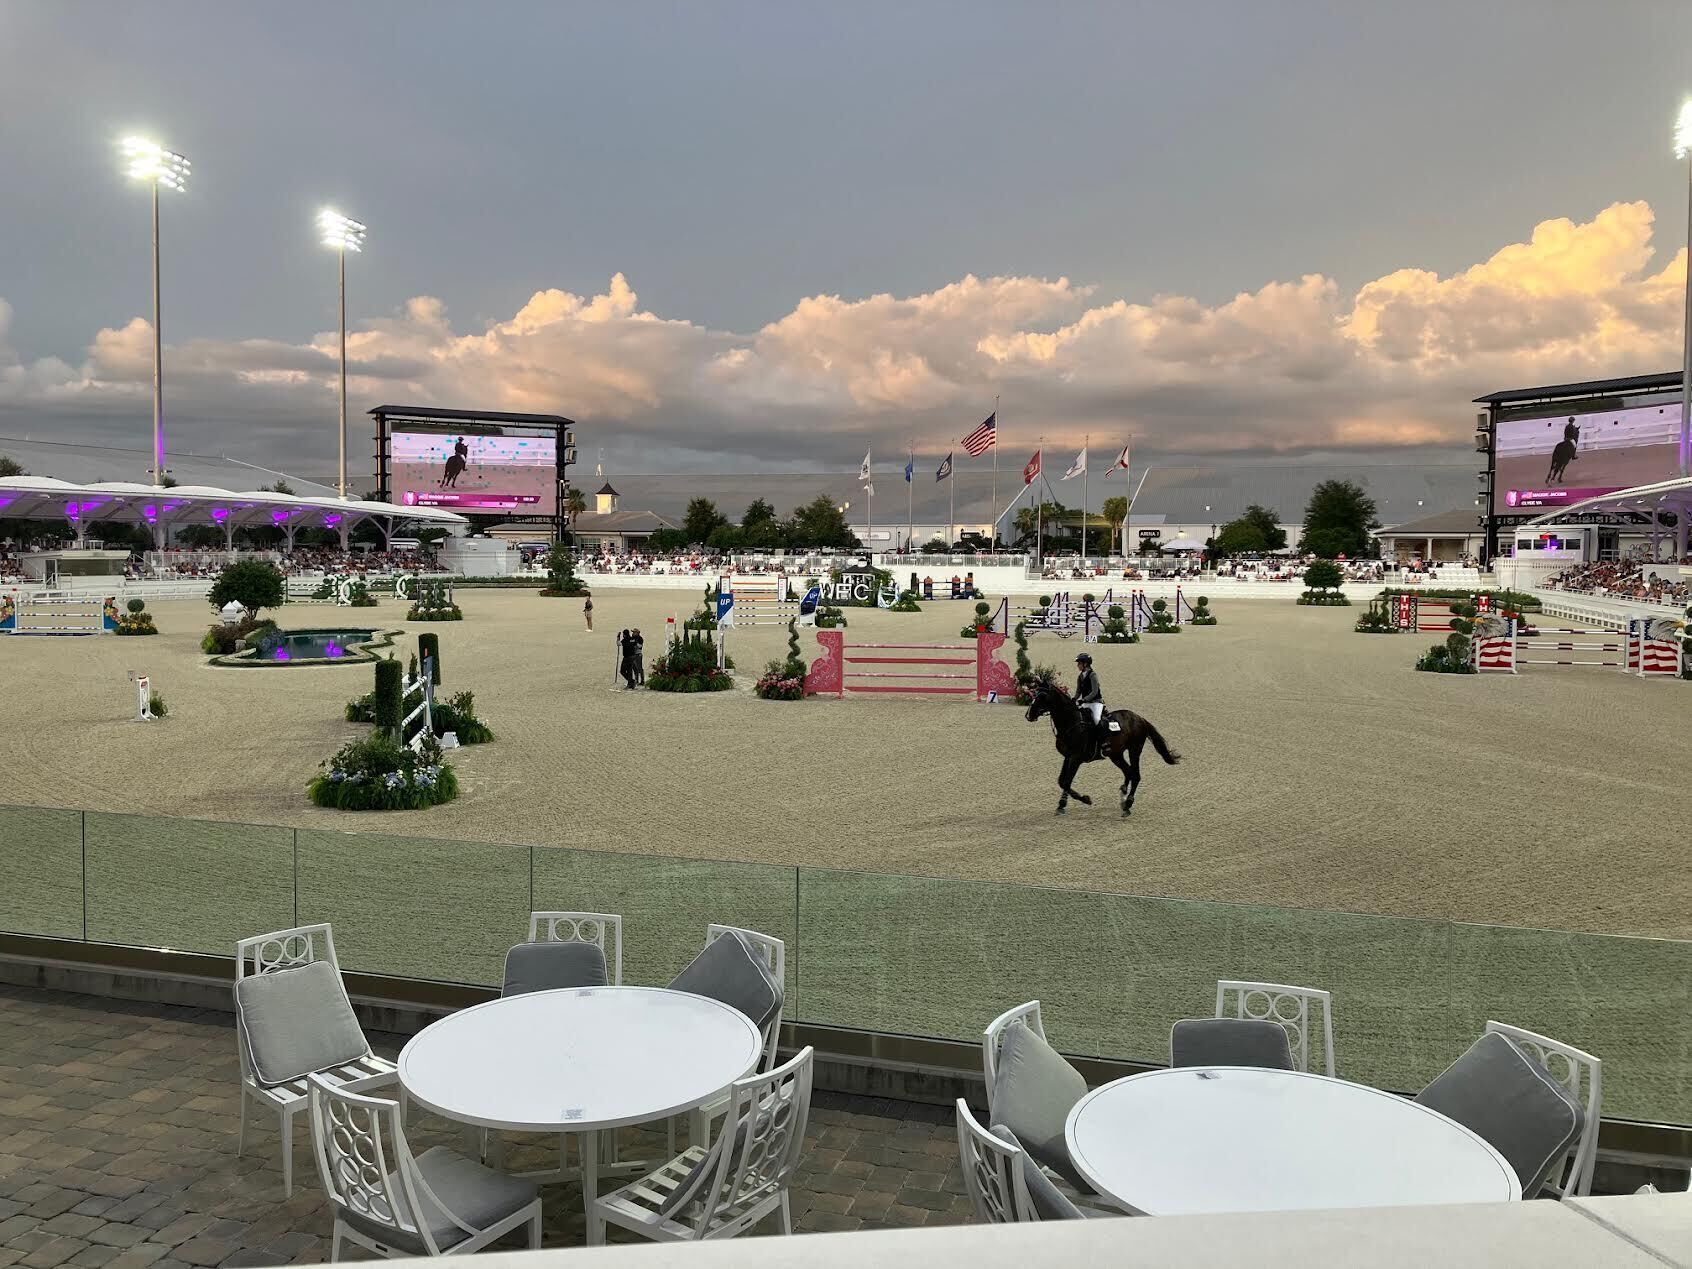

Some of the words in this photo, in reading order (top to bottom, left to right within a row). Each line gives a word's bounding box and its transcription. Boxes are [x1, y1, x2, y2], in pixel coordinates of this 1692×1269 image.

[720, 598, 731, 606] UP
[1479, 596, 1488, 612] TH
[1400, 595, 1409, 627] THIS
[990, 691, 997, 703] 7
